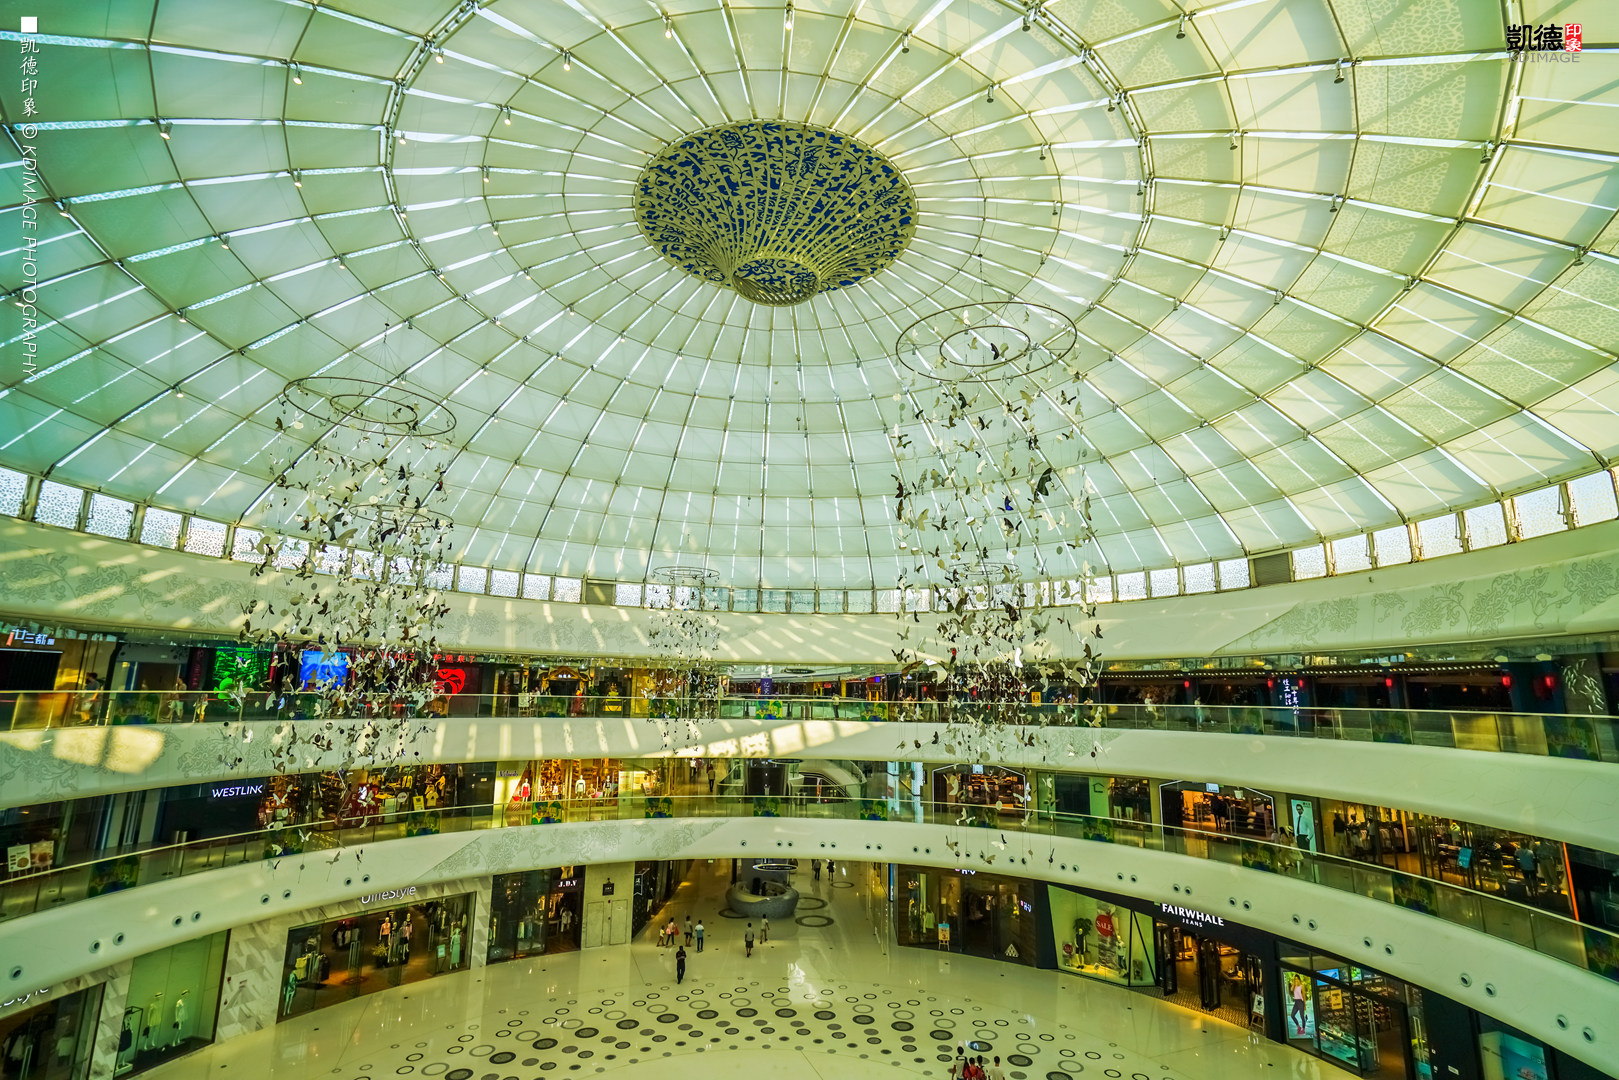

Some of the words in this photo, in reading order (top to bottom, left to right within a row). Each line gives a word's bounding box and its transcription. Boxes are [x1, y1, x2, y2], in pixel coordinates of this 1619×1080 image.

[212, 784, 264, 798] WESTLINK
[1162, 903, 1225, 927] FAIRWHALE
[1096, 920, 1113, 932] SALE
[1182, 918, 1203, 928] JEANS
